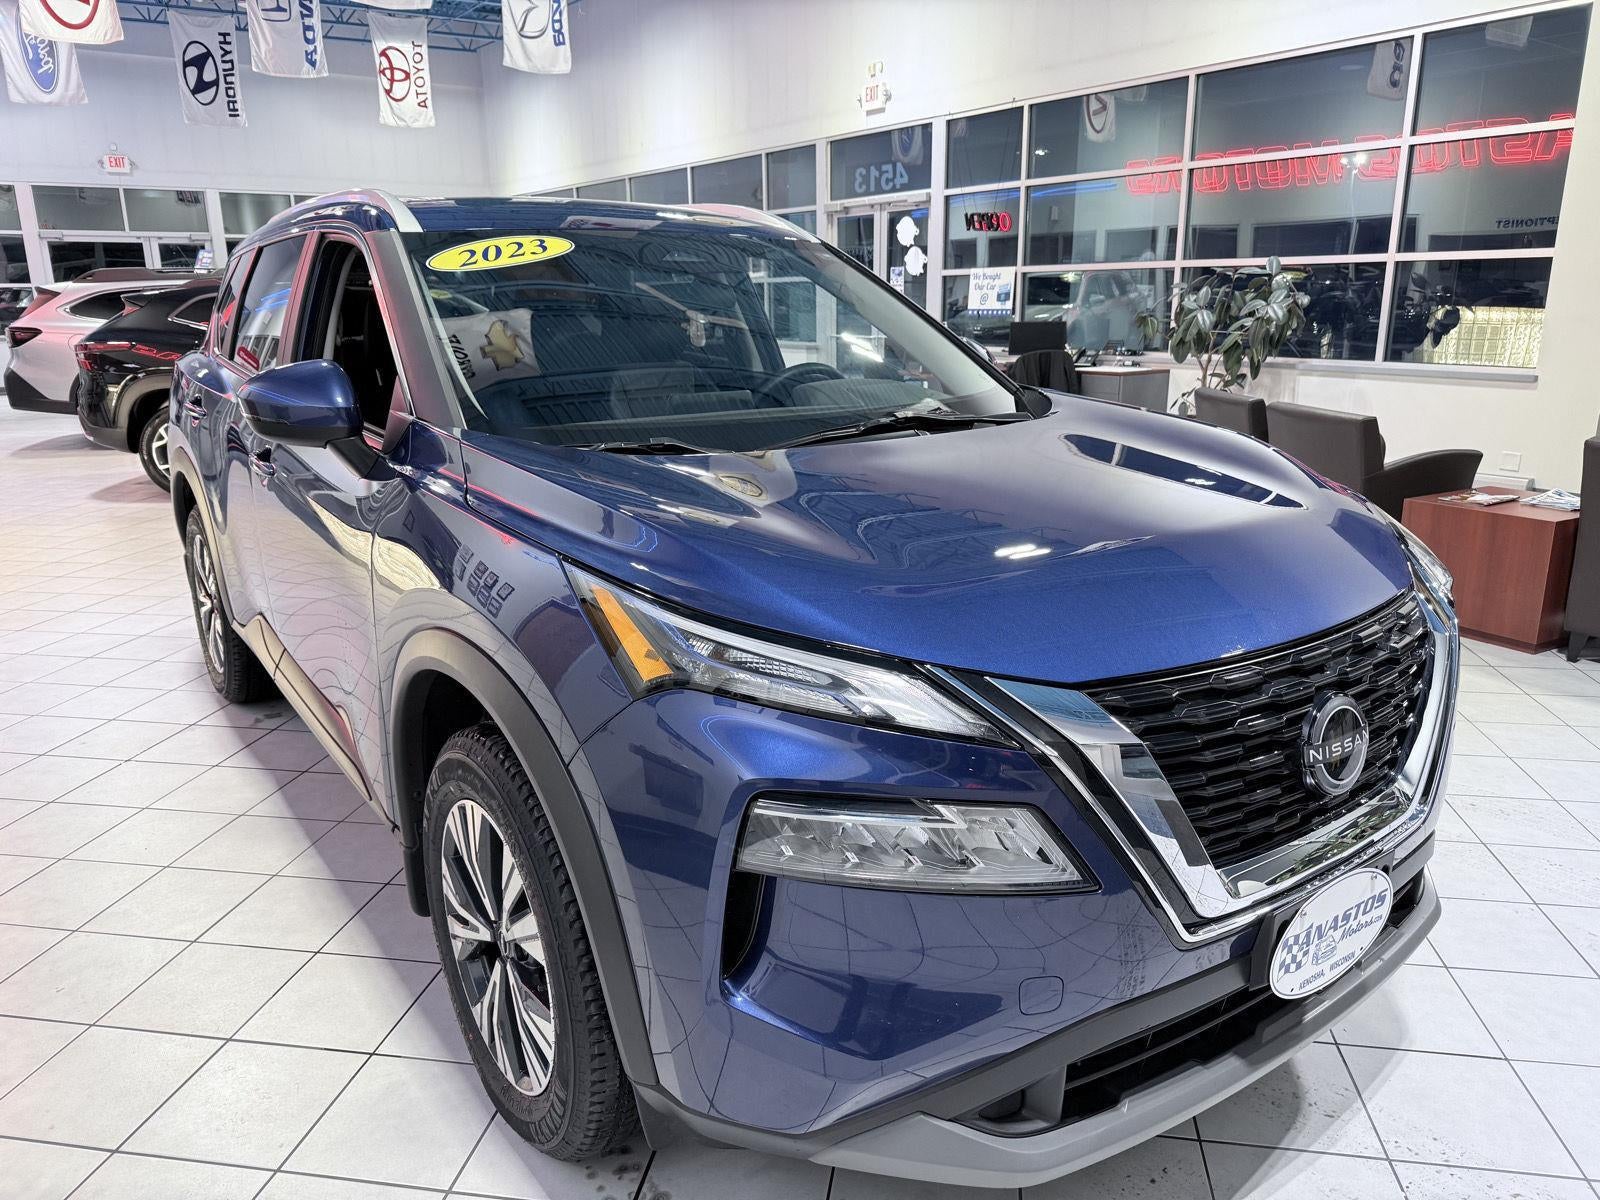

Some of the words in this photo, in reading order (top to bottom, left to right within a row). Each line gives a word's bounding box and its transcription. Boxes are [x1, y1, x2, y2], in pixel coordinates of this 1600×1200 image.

[865, 84, 879, 103] EXIT
[108, 155, 126, 168] EXIT
[458, 238, 549, 268] 2023
[982, 271, 1002, 283] Bought
[1309, 729, 1369, 763] NISSAN
